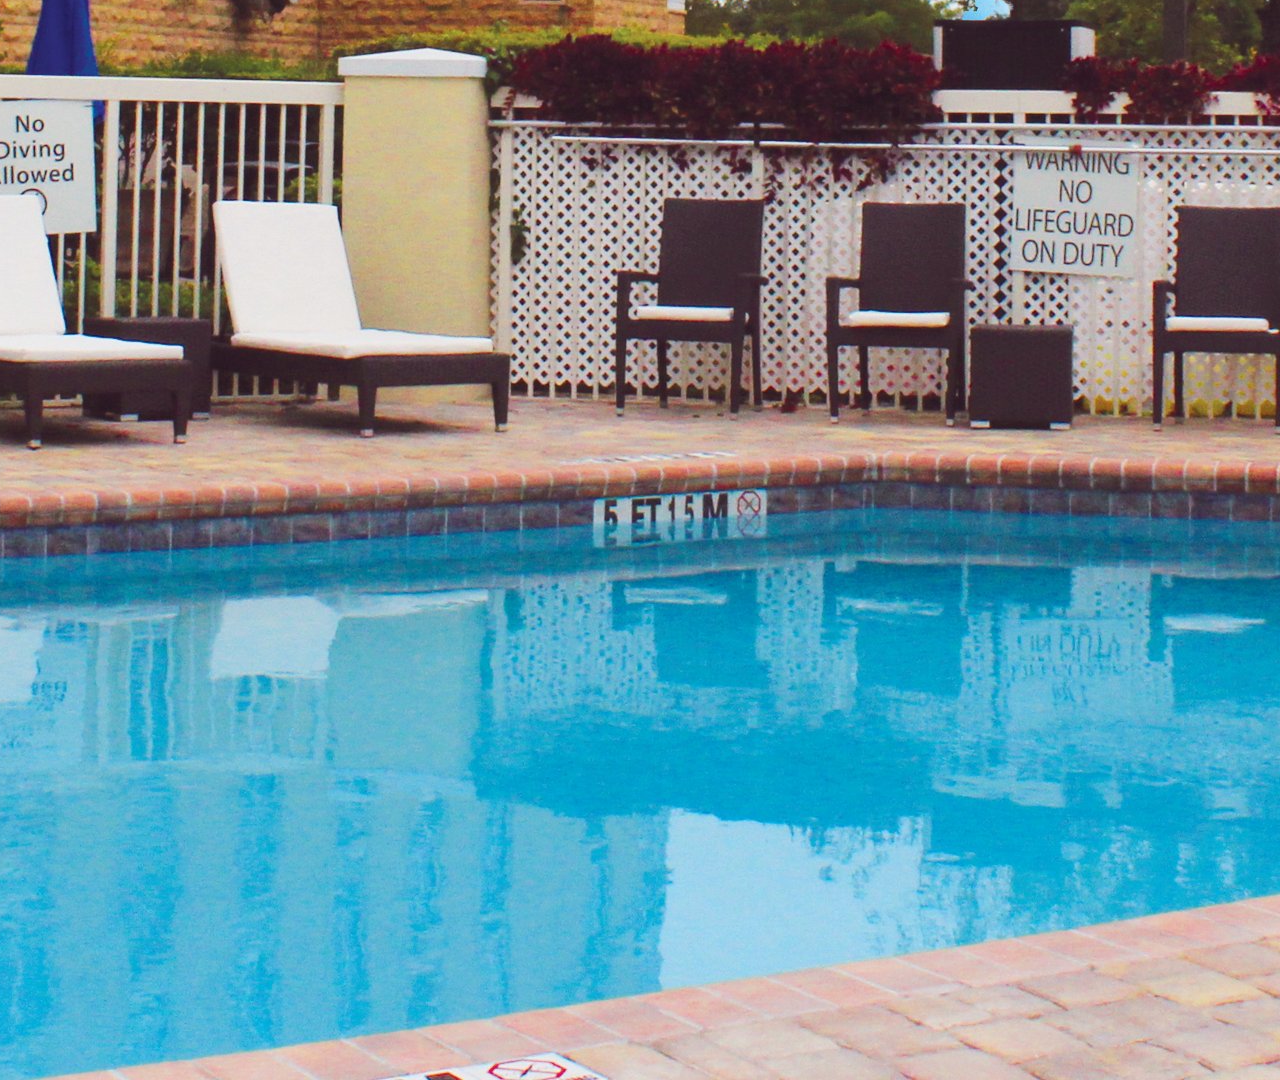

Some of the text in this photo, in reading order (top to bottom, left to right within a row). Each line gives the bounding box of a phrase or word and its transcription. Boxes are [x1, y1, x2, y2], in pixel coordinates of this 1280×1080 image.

[15, 114, 45, 133] No
[1025, 151, 1130, 175] WARNING
[1058, 179, 1093, 204] NO
[1015, 208, 1134, 238] LIFEGUARD
[1022, 239, 1124, 268] ON DUTY
[702, 492, 728, 519] M
